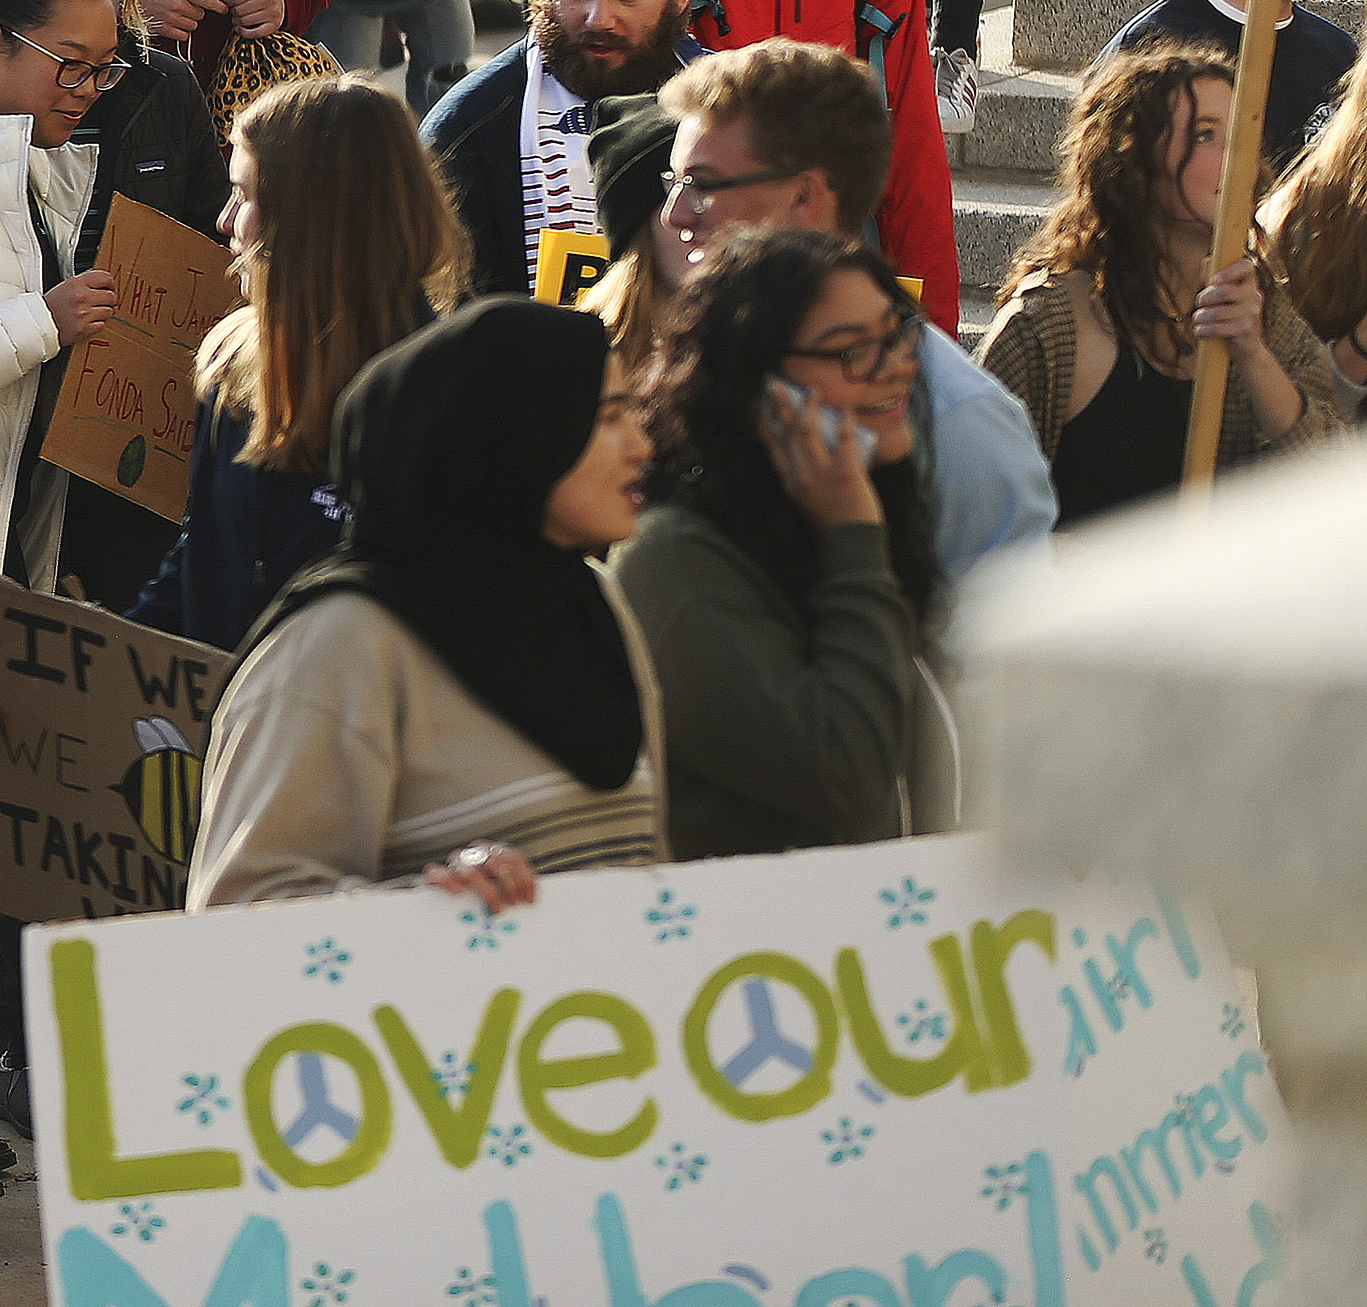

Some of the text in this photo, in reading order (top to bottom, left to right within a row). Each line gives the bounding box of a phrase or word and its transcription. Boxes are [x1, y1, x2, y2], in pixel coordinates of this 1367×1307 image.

[73, 339, 145, 427] FONDA
[3, 608, 214, 723] IF WE
[49, 908, 1059, 1202] Love our
